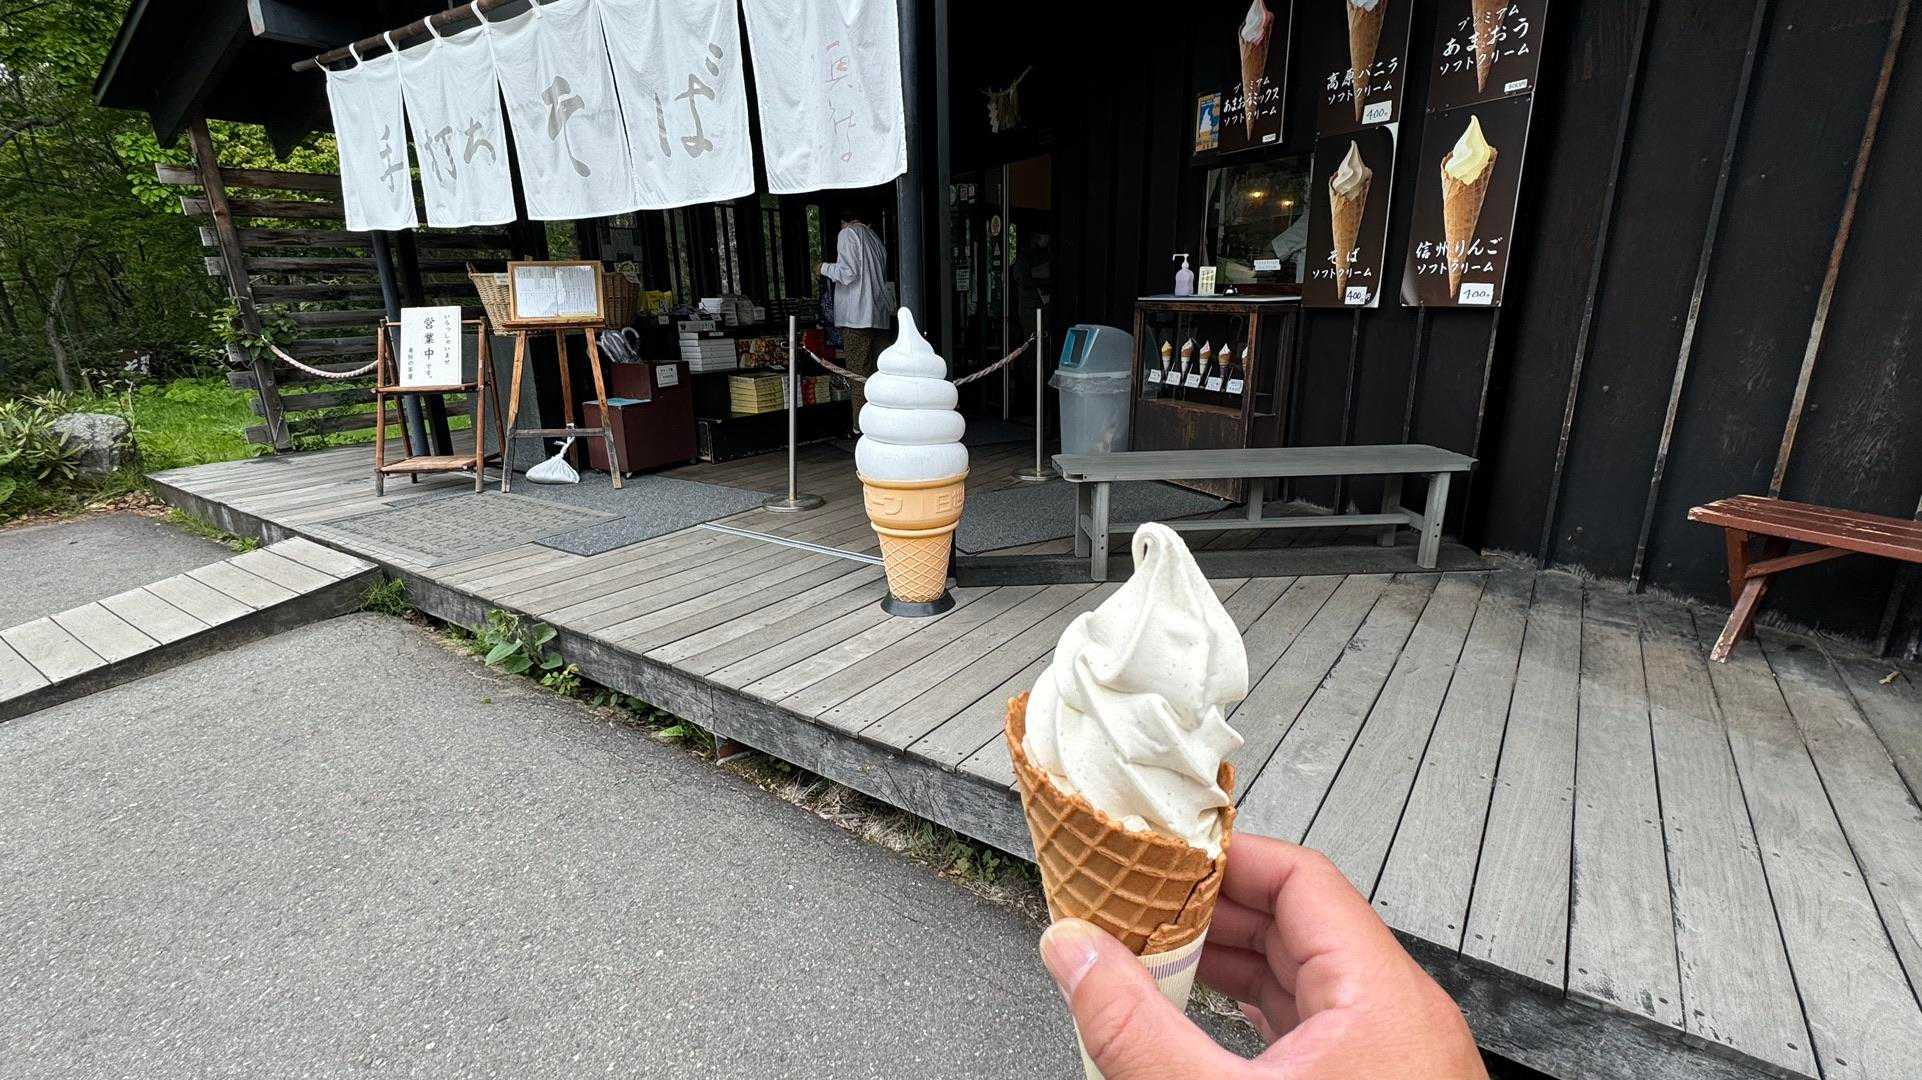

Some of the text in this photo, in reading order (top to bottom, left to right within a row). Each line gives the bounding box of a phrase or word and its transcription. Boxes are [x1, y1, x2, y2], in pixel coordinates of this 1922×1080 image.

[1442, 16, 1529, 57] あまおう
[1439, 42, 1530, 77] ソフトクリーム
[1327, 56, 1398, 90] 高原バニラ
[1233, 76, 1270, 94] プミアム
[1327, 79, 1393, 105] ソフトクリーム
[1223, 105, 1277, 127] ソフトクリーム
[1416, 236, 1503, 259] 信州りんご
[1312, 267, 1372, 279] ソフトクリーム
[1417, 260, 1494, 275] ソフトクリーム
